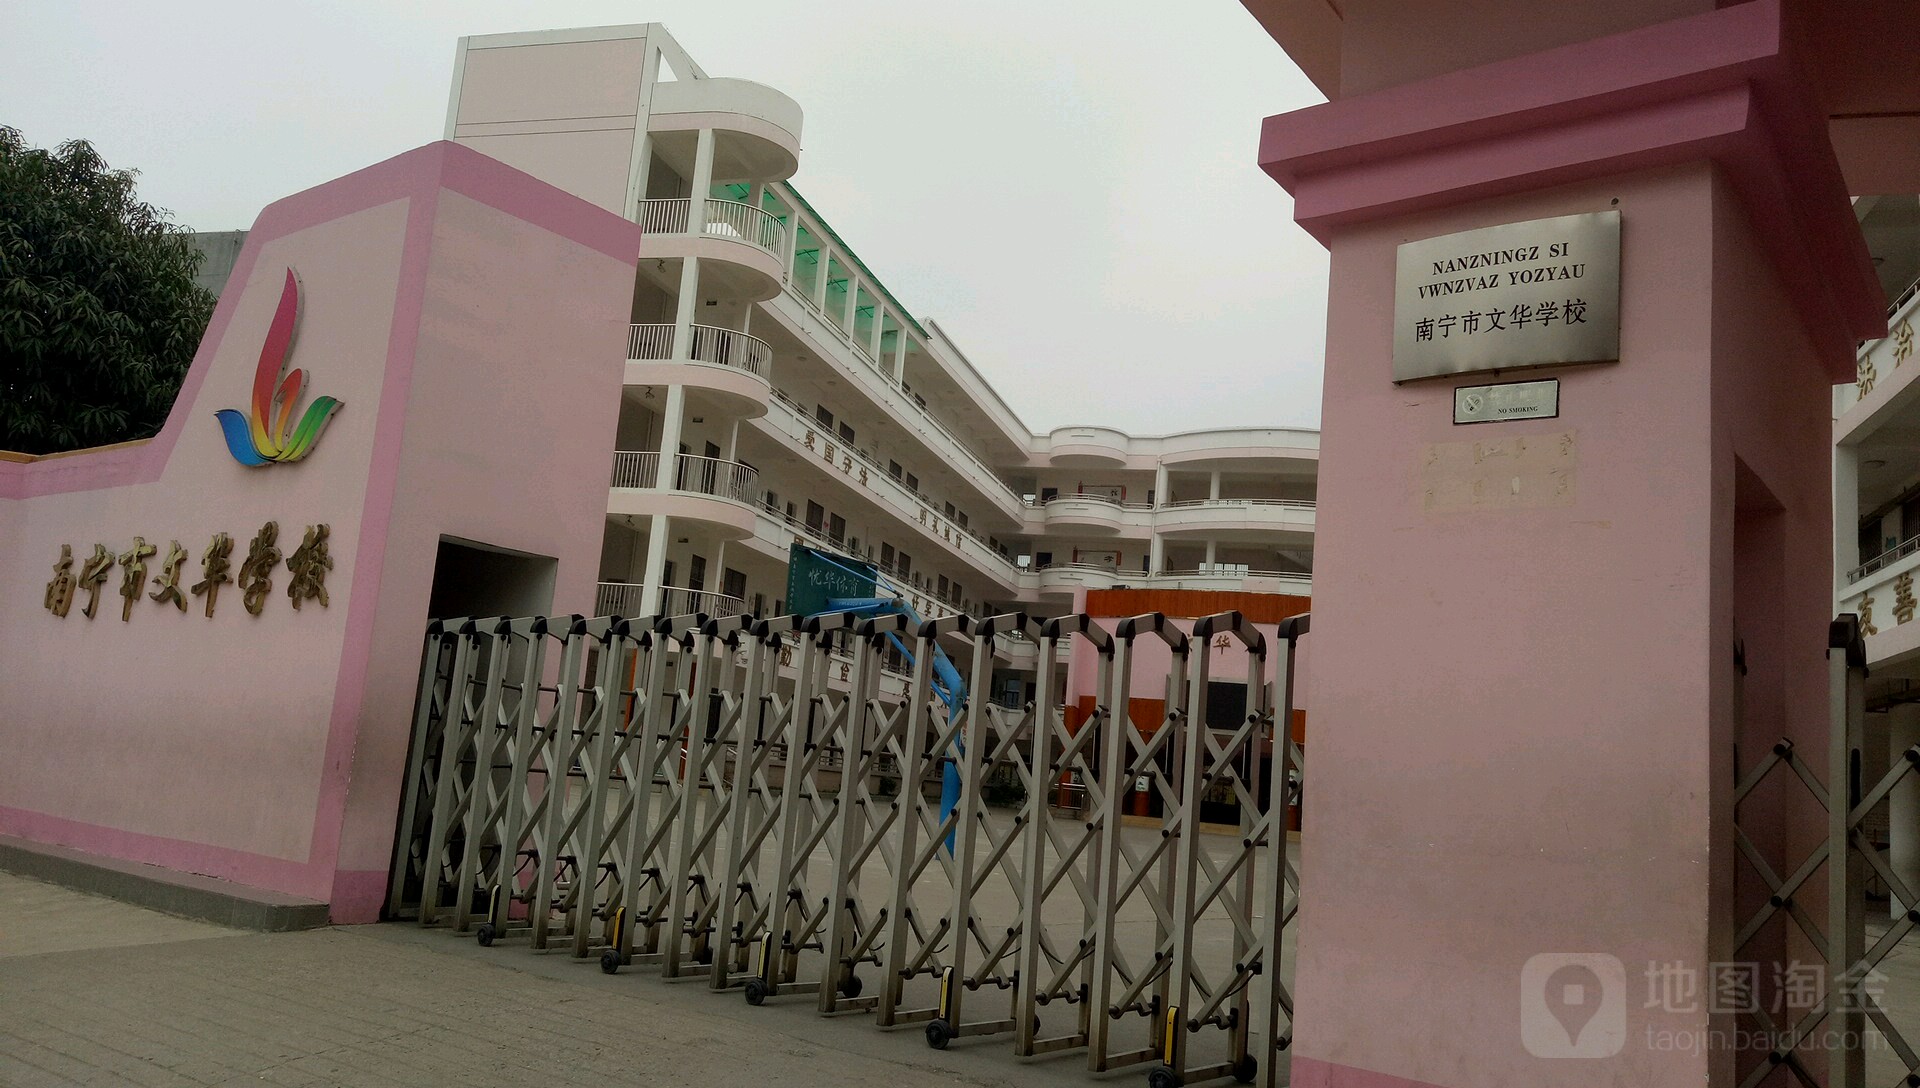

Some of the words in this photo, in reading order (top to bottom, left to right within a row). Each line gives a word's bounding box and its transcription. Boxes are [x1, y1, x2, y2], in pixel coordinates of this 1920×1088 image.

[1432, 246, 1540, 275] NANZNINGZ
[1548, 242, 1569, 258] SI
[1418, 274, 1499, 299] VWNZVAZ
[1509, 263, 1586, 286] YOZYAU
[1414, 299, 1588, 343] 南宁市文华学校
[1508, 406, 1539, 414] SMOKING
